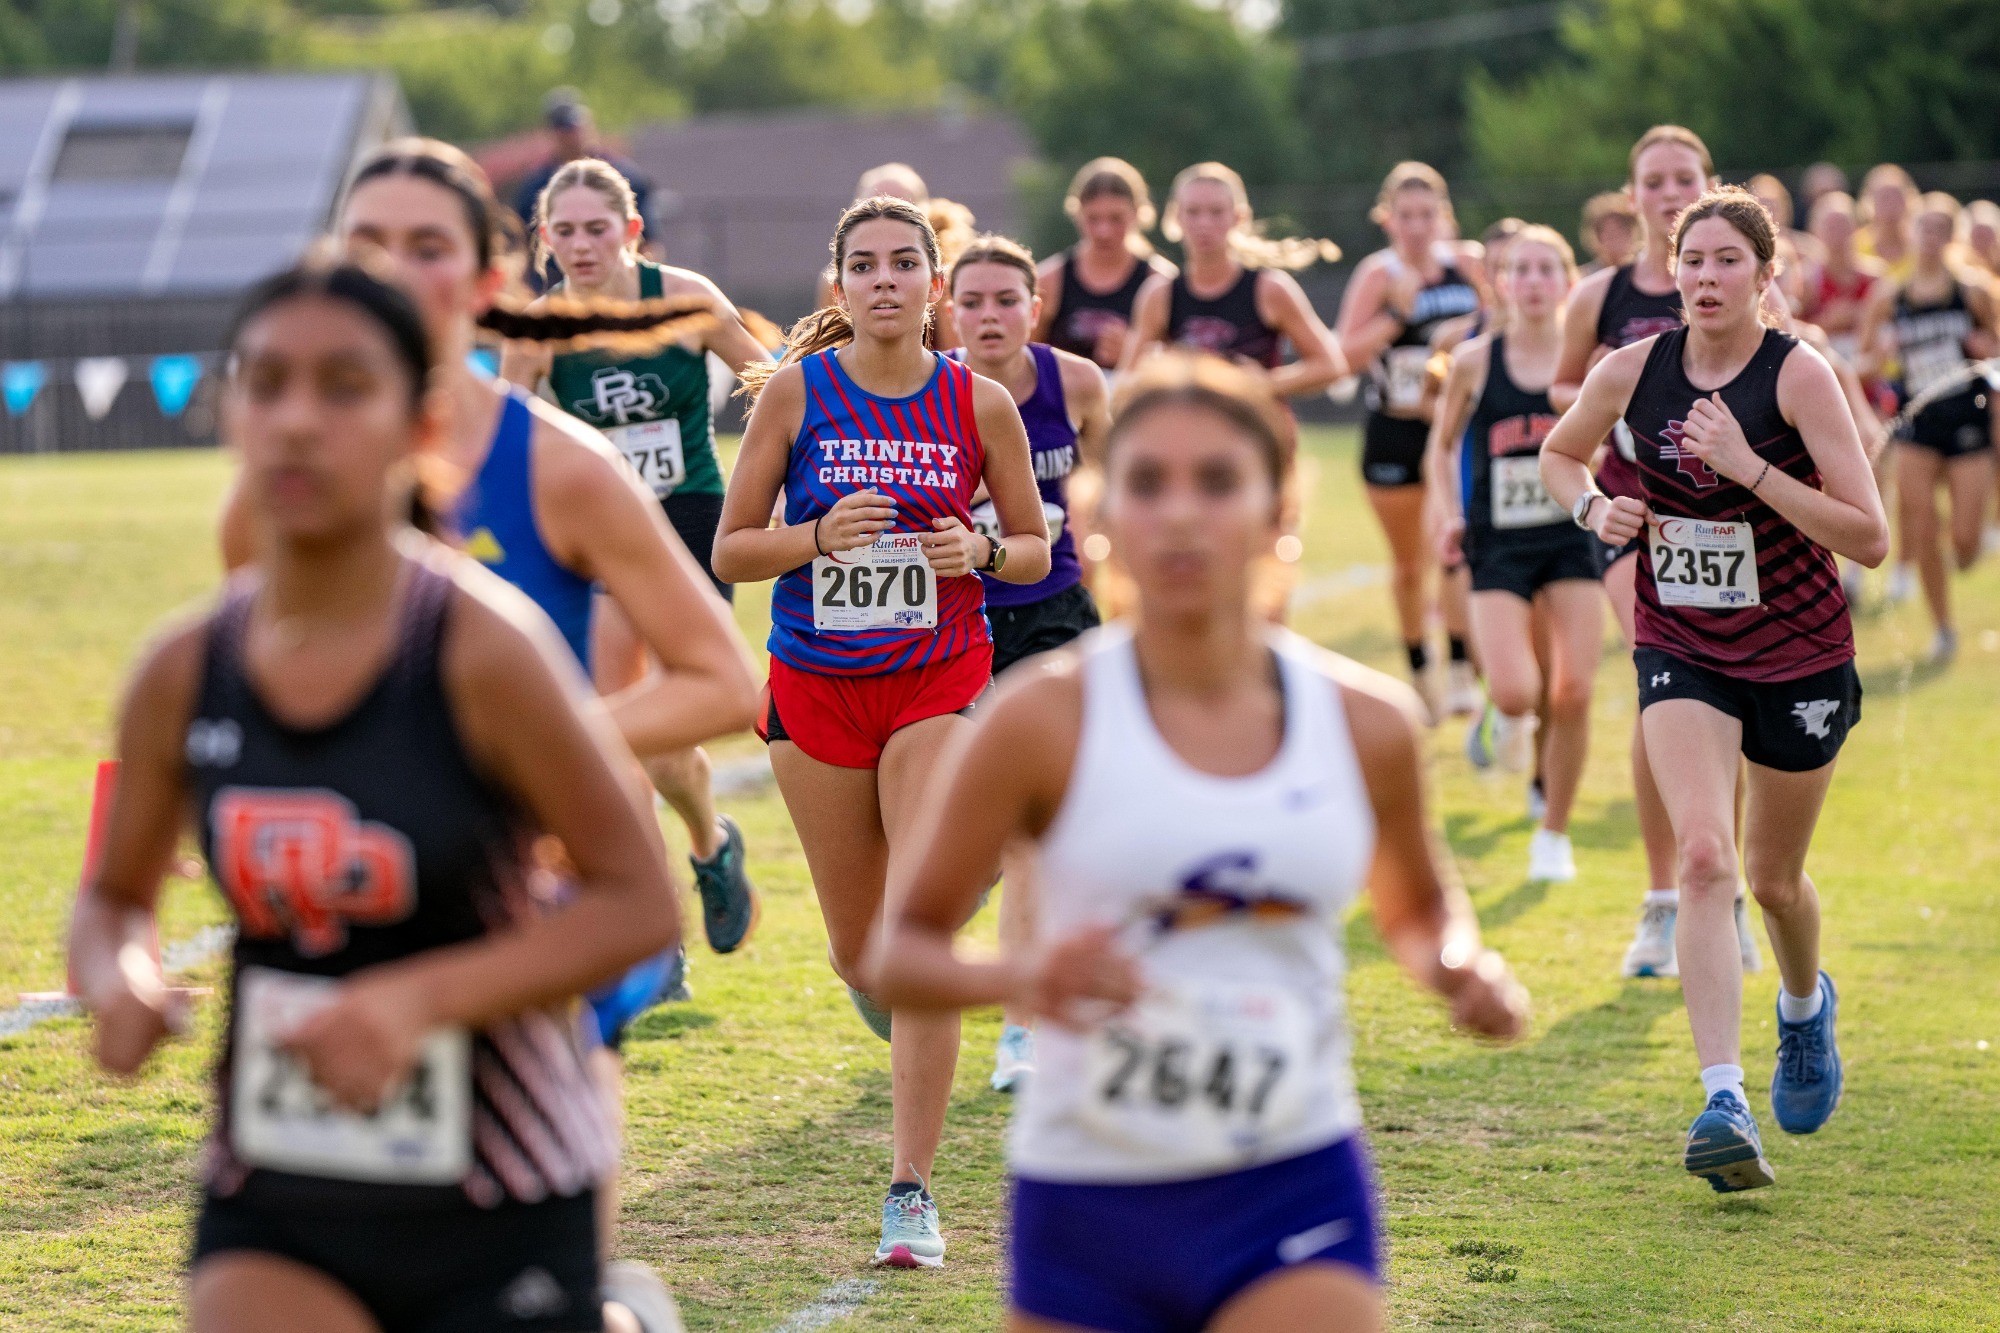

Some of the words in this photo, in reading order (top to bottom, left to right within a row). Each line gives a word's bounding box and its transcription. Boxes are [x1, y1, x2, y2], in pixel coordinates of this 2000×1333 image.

[623, 447, 674, 480] 75
[819, 439, 958, 467] TRINITY
[1035, 444, 1074, 481] AINS
[818, 466, 958, 489] CHRISTIAN
[871, 537, 918, 549] RunFAR
[1695, 523, 1736, 535] RunFAR
[1655, 545, 1745, 587] 2357
[821, 565, 926, 608] 2670
[894, 610, 923, 621] COWTOWN
[1101, 1026, 1287, 1116] 2647
